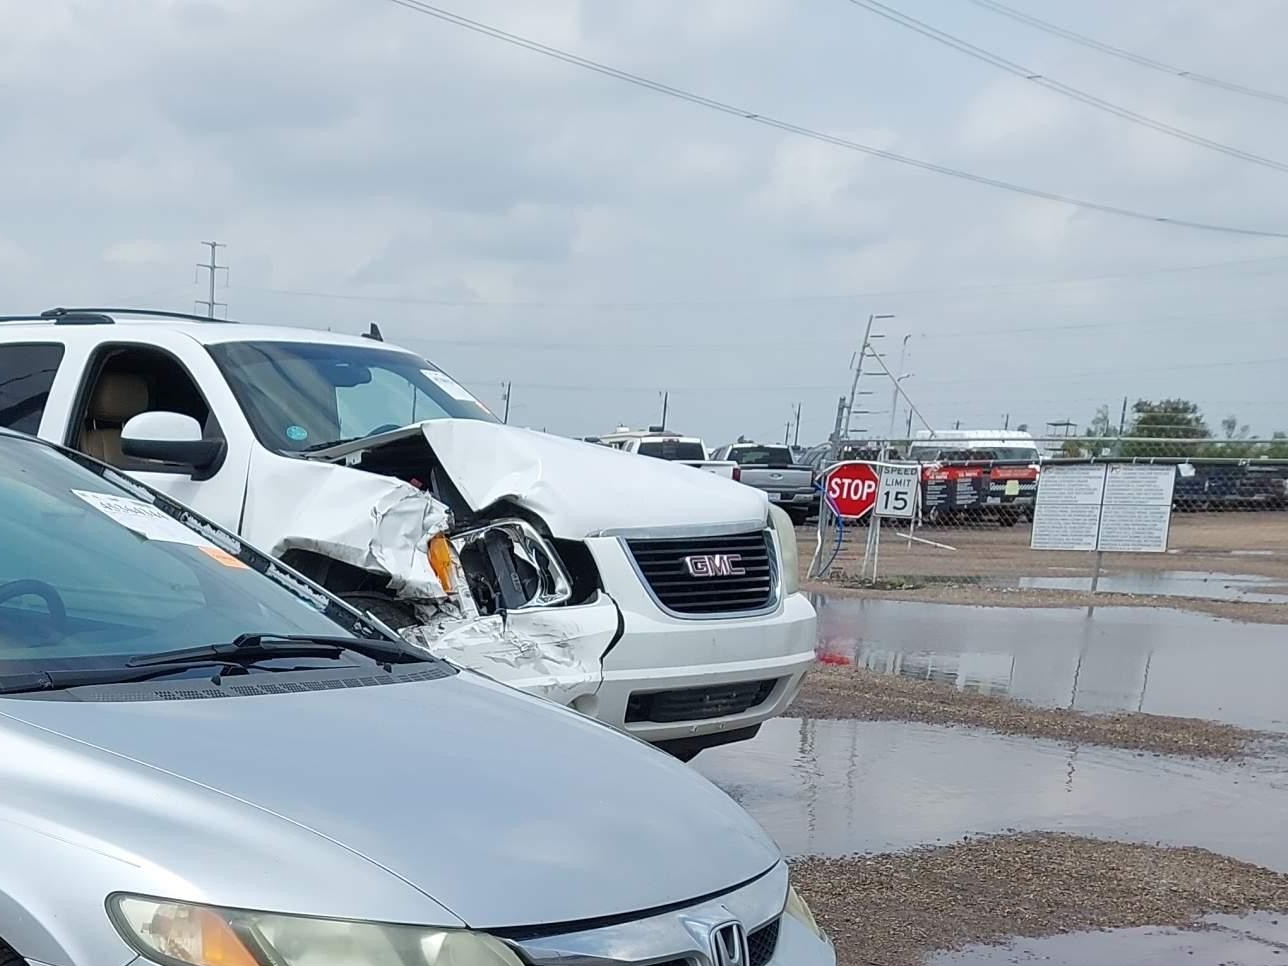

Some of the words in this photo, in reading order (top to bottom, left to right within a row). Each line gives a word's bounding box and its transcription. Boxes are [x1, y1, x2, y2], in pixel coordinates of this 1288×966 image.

[884, 467, 917, 475] SPEED
[829, 478, 875, 500] STOP
[885, 479, 911, 487] LIMIT
[884, 491, 908, 510] 15
[685, 554, 746, 577] GMC
